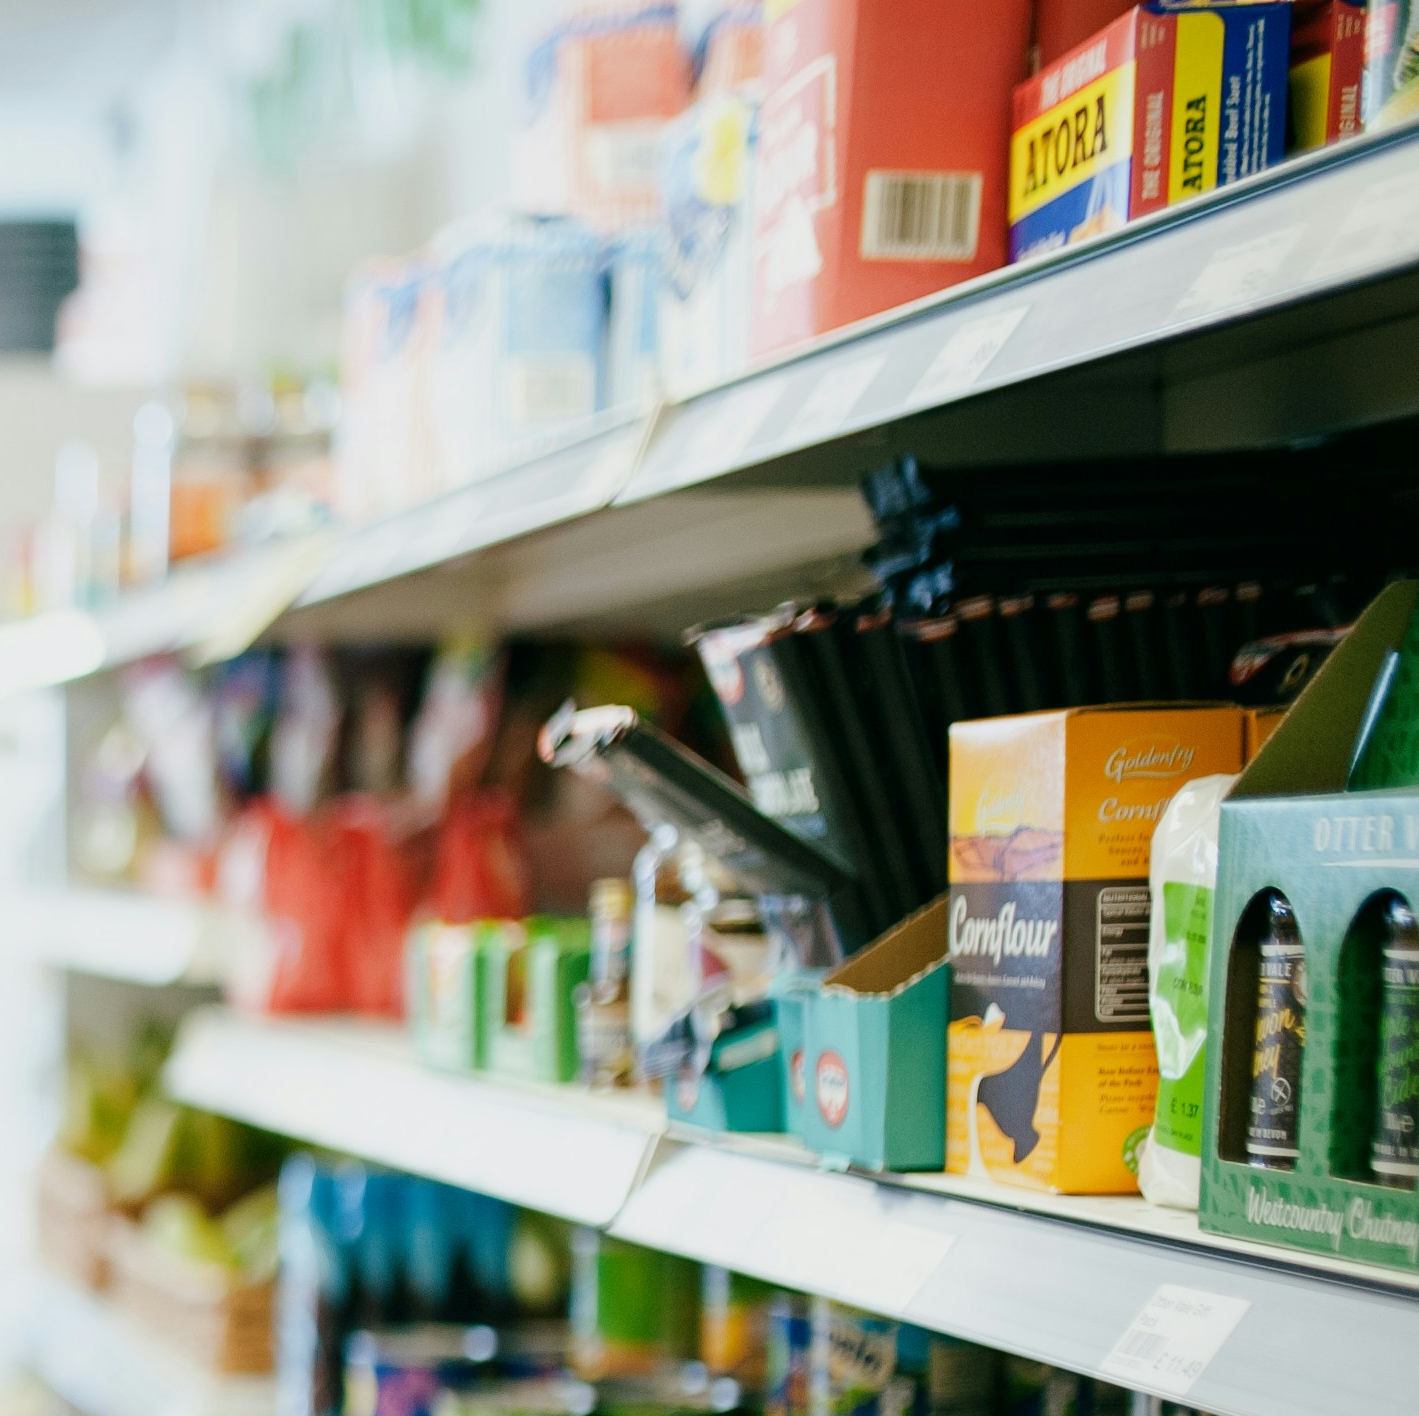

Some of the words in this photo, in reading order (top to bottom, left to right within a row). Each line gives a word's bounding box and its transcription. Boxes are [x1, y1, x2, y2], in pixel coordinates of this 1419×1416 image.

[1024, 92, 1109, 197] ATORA
[1182, 91, 1207, 192] ATORA
[1105, 744, 1195, 783] Goldenfry
[1316, 815, 1394, 852] OTTER
[948, 894, 1058, 969] Cornflour
[1246, 1186, 1344, 1251] Westcountry
